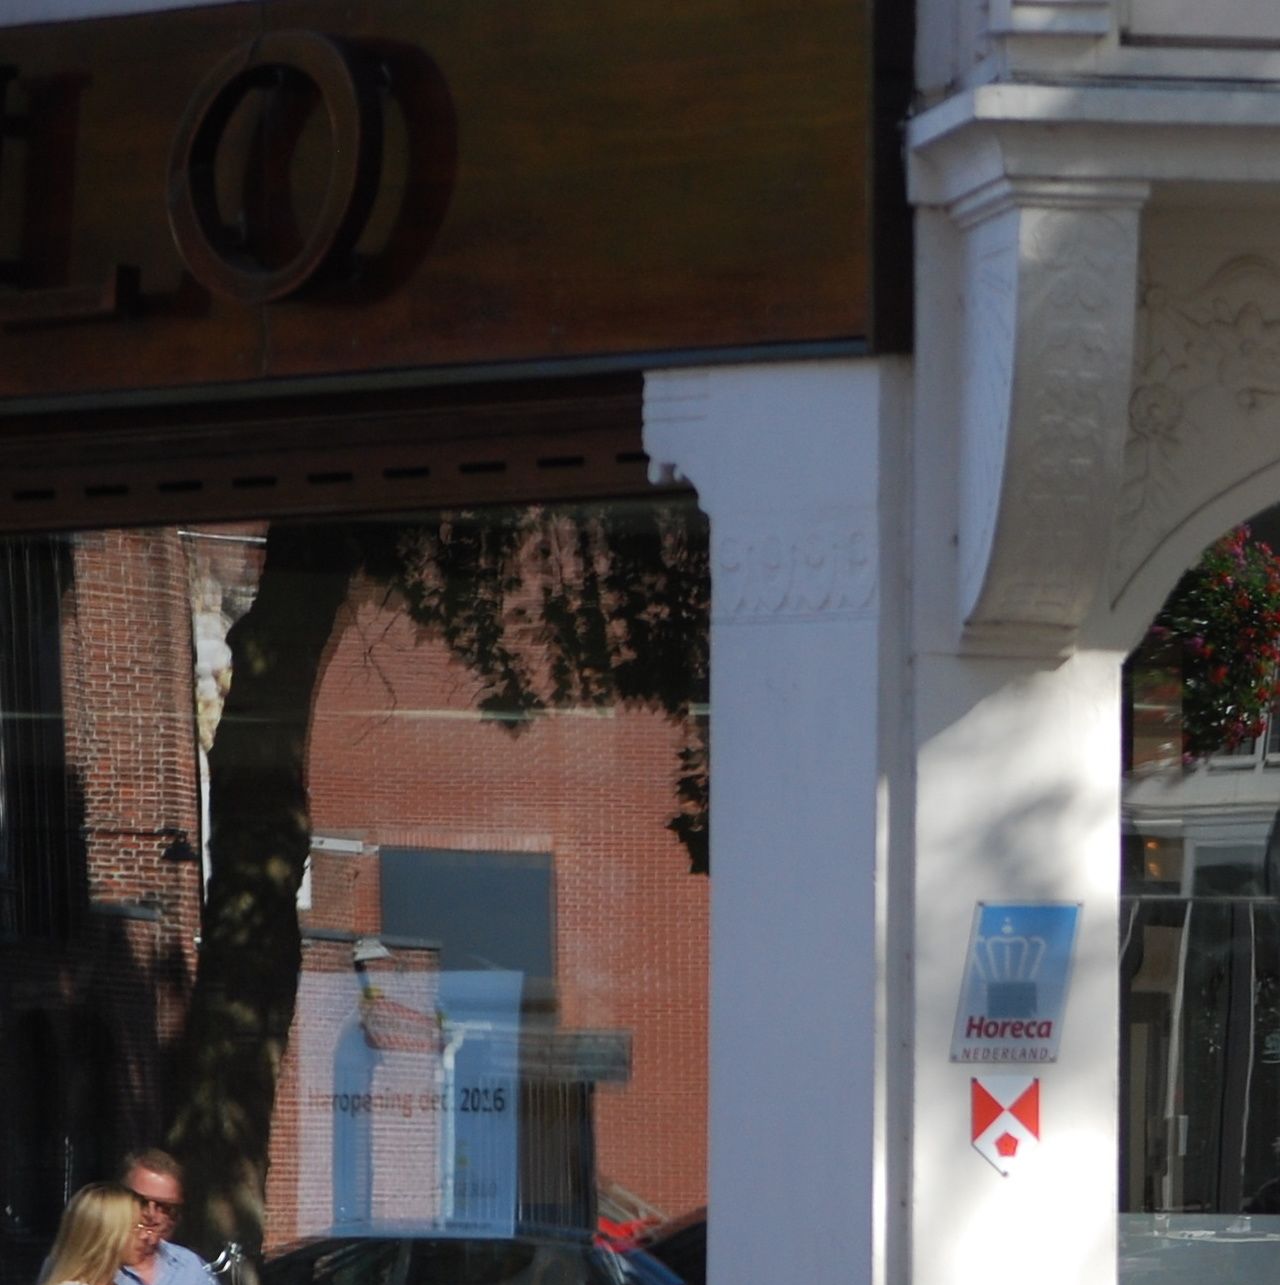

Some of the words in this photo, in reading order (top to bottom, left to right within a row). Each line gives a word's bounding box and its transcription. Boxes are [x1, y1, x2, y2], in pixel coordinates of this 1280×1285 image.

[965, 1015, 1054, 1040] Horeca
[961, 1047, 1050, 1061] NEDERLAND
[460, 1087, 506, 1113] 2016
